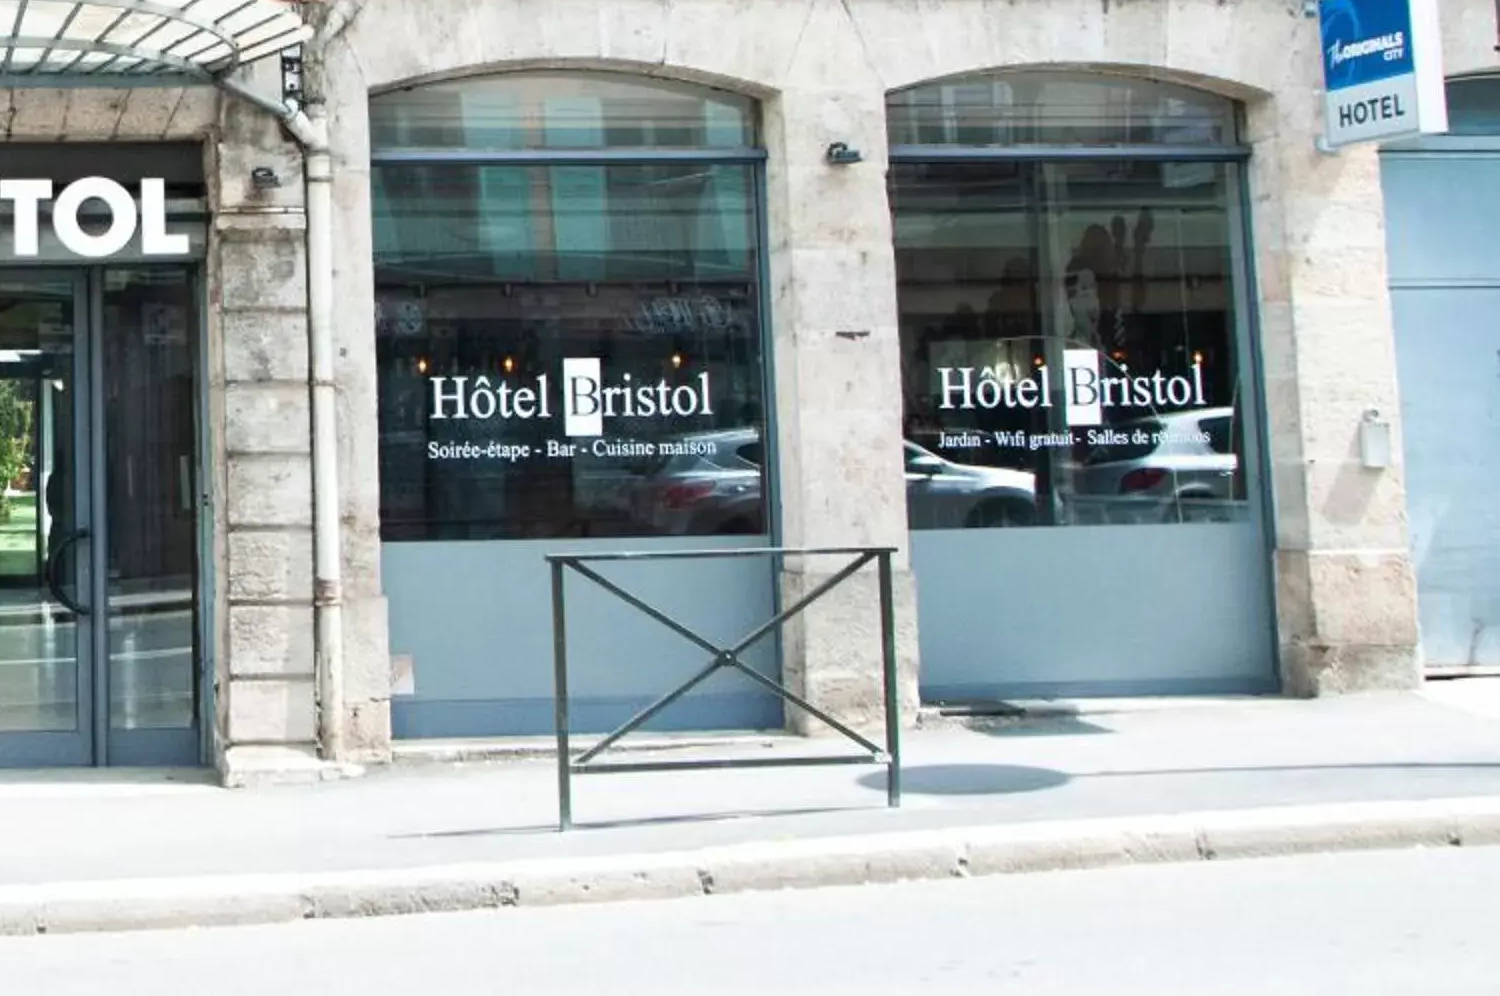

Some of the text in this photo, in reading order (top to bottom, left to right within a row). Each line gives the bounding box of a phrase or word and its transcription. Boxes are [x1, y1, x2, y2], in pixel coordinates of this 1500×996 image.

[1384, 47, 1404, 61] CITY
[1339, 94, 1405, 128] HOTEL
[429, 372, 714, 419] Hôtel Bristol
[937, 363, 1208, 410] Hôtel Bristol
[428, 441, 530, 462] Soirée-étape
[546, 440, 577, 457] Bar
[592, 439, 655, 457] Cuisine
[658, 439, 717, 455] maison
[938, 431, 981, 448] Jardin
[995, 430, 1025, 445] Wifi
[1029, 431, 1075, 450] gratuit
[1087, 430, 1129, 445] Salles
[1131, 428, 1150, 444] de
[1153, 429, 1211, 444] réons
